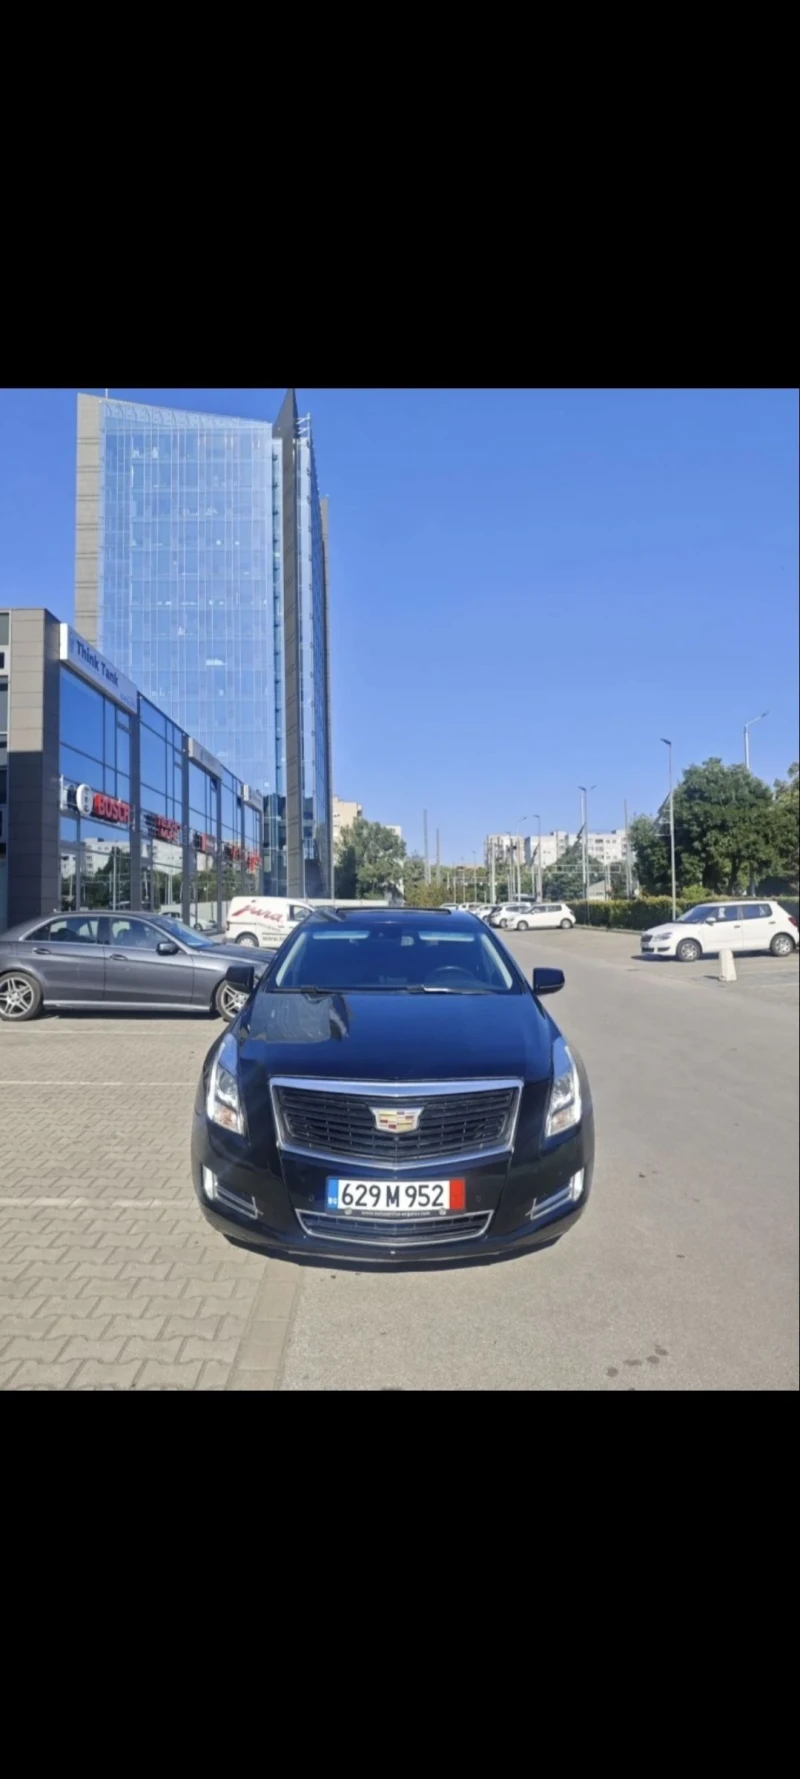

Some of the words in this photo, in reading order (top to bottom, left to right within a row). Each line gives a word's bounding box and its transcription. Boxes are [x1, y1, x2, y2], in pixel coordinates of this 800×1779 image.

[76, 640, 100, 672] Think
[100, 661, 119, 688] Tank
[98, 797, 130, 823] BOSCH
[341, 1183, 381, 1208] 629
[386, 1185, 400, 1208] M
[405, 1184, 444, 1207] 952
